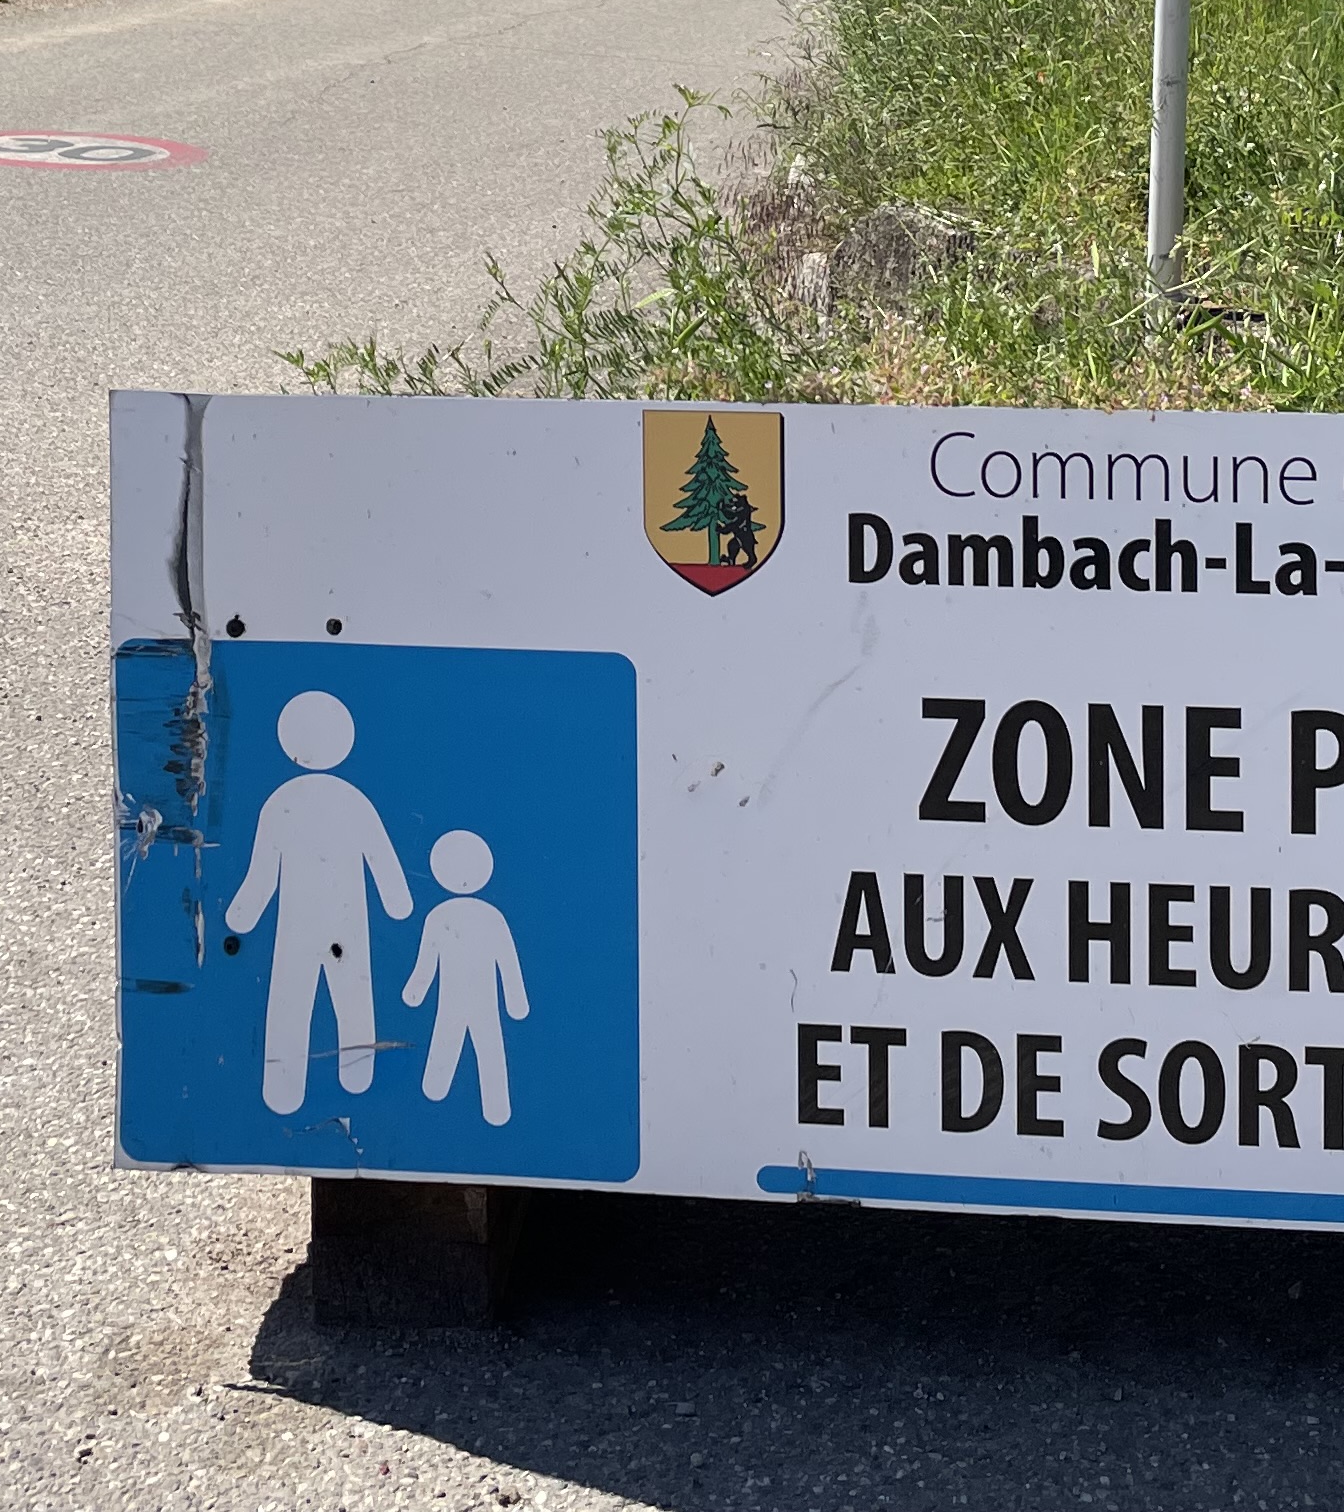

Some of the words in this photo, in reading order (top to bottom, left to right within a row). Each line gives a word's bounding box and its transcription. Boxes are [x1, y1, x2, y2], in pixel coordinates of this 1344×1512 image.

[929, 431, 1318, 505] Commune
[918, 697, 1244, 834] ZONE
[830, 870, 1035, 982] AUX
[795, 1023, 907, 1129] ET
[940, 1029, 1065, 1138] DE
